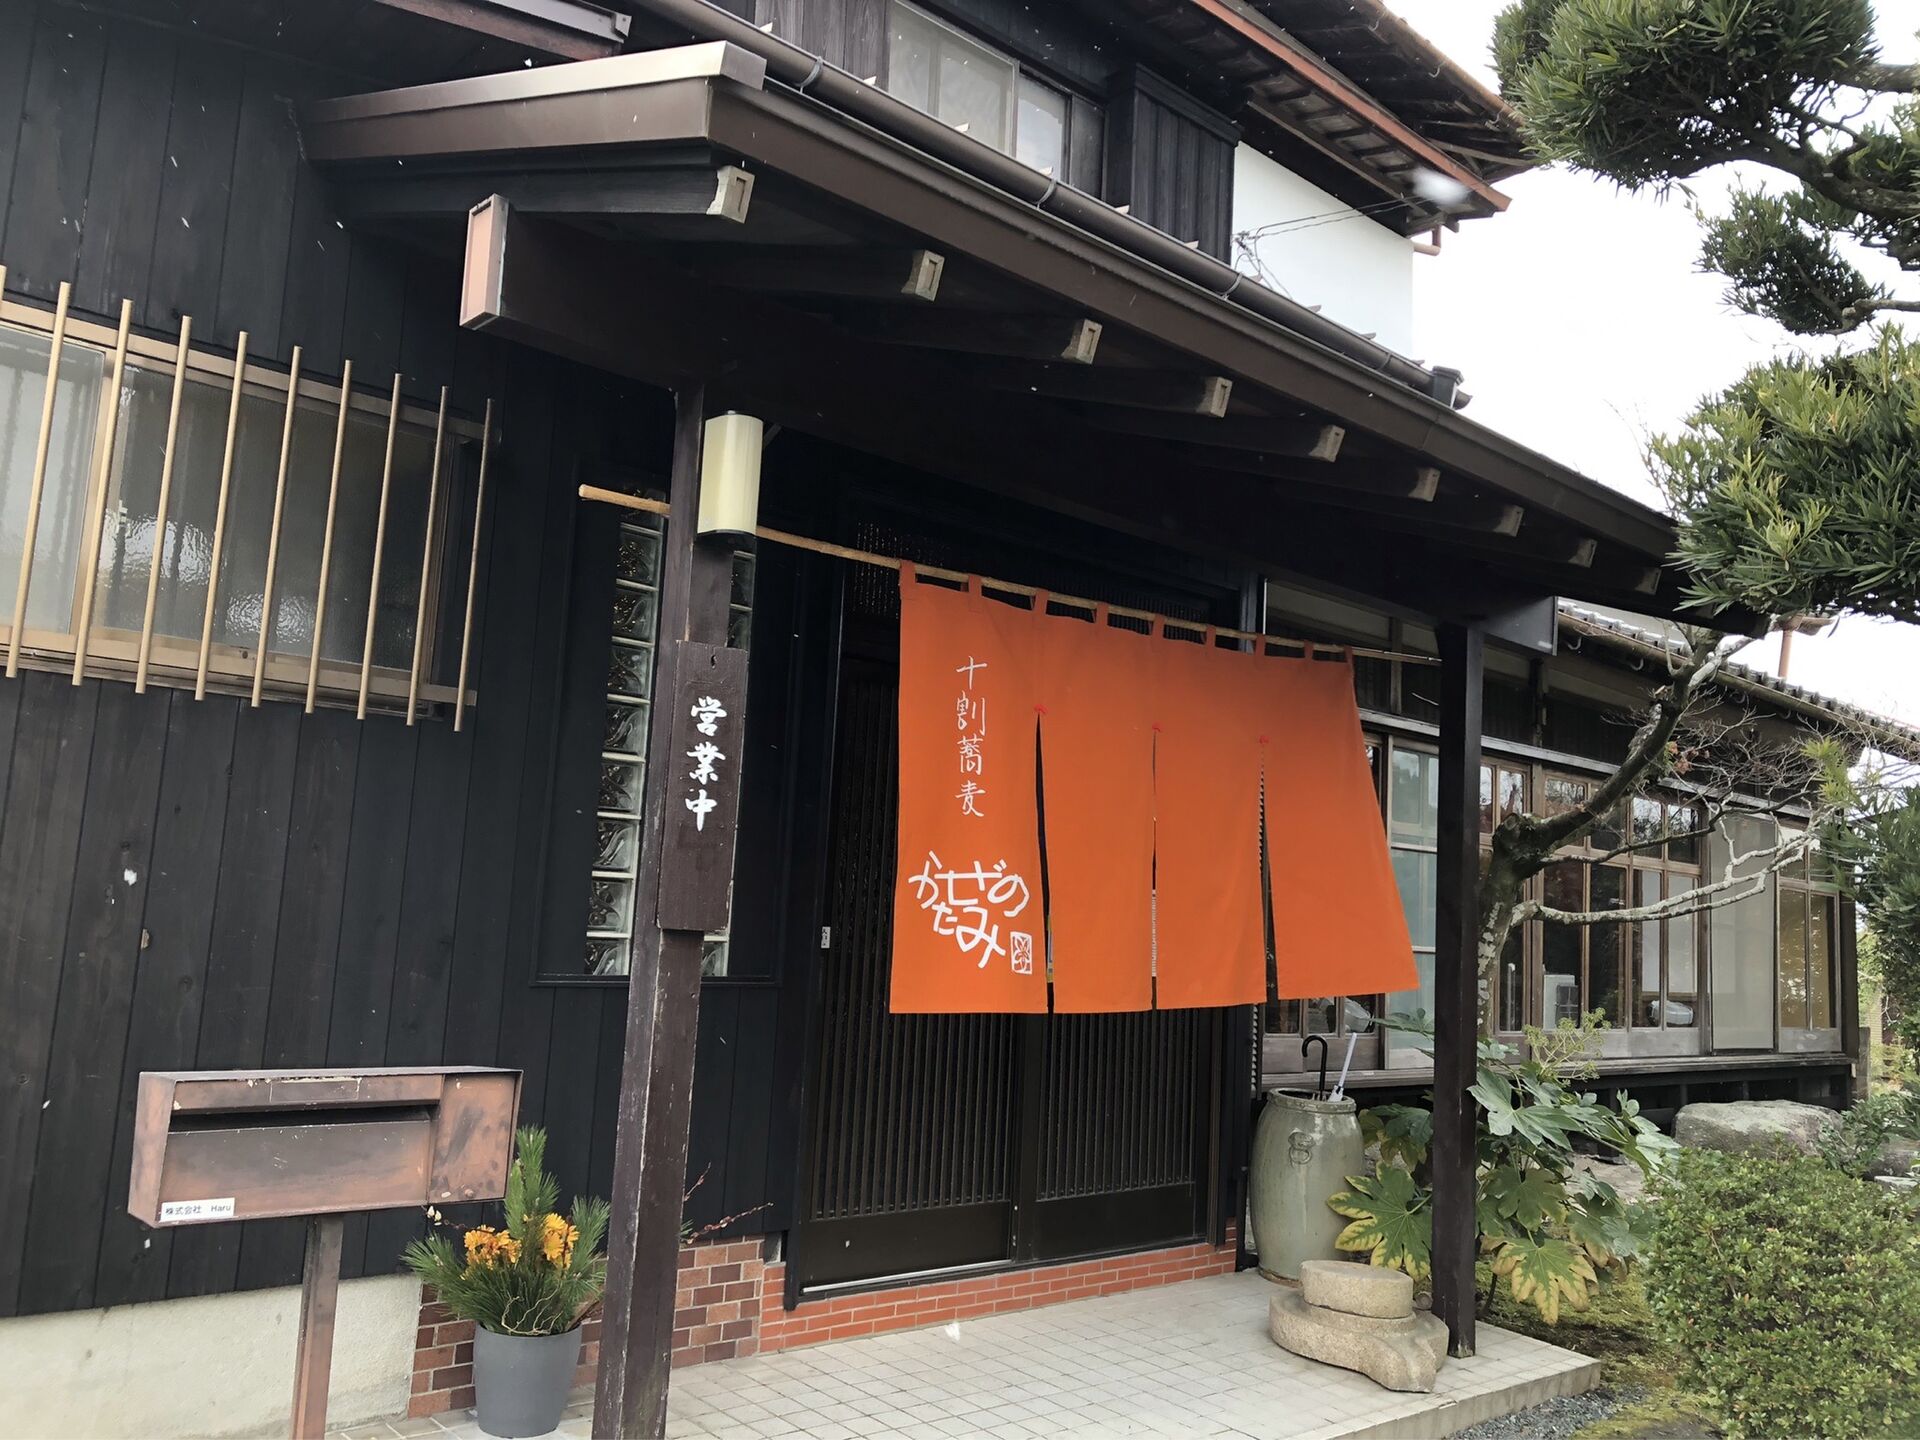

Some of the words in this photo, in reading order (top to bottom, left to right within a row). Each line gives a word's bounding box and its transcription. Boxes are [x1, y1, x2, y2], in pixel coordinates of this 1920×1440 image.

[684, 696, 727, 832] 営業中
[955, 655, 988, 817] 十割蕎麦
[931, 901, 1006, 969] たみ
[165, 1205, 202, 1216] 株式会社
[210, 1204, 232, 1213] Haru
